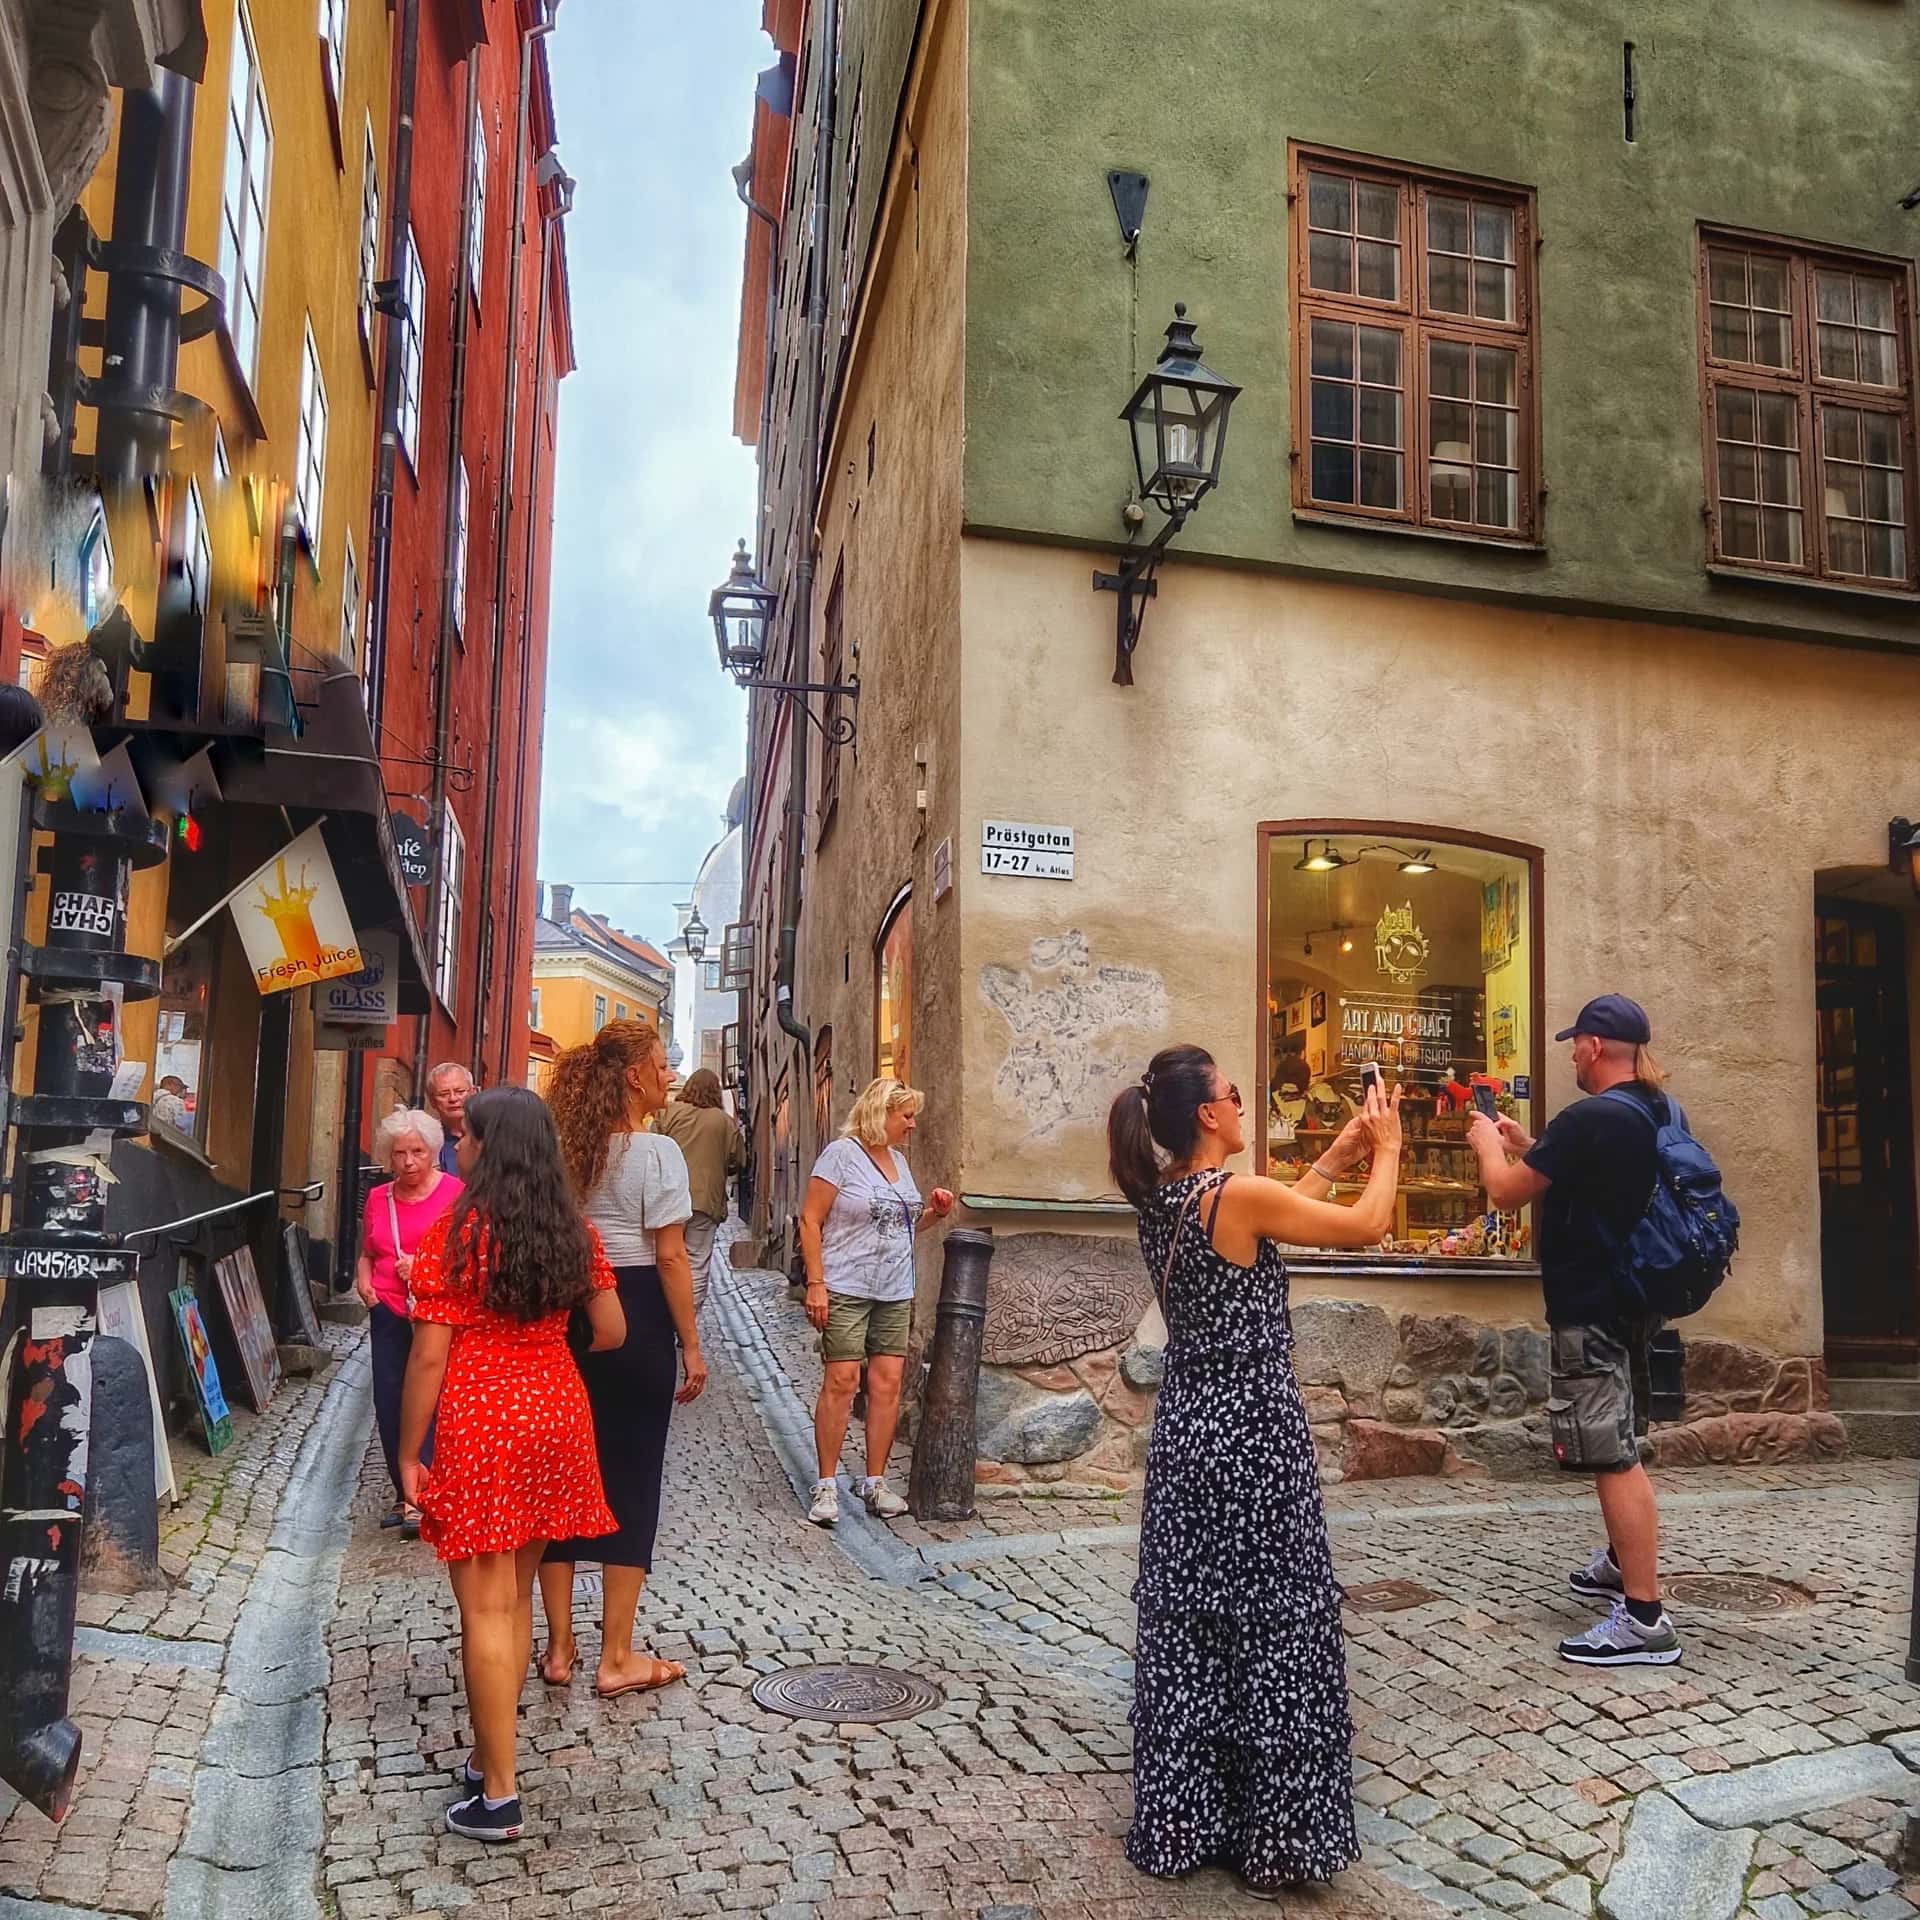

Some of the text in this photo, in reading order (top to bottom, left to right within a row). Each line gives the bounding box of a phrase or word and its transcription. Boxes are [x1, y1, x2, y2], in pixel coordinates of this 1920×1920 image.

[987, 826, 1070, 848] Prästgatan
[986, 852, 1030, 871] 17-27
[55, 893, 114, 915] CHAF
[52, 910, 111, 932] CHAF
[257, 947, 357, 981] Fresh Juice
[329, 989, 385, 1008] GLASS
[1342, 1007, 1453, 1038] ART AND CRAFT
[1404, 1046, 1453, 1066] GIFTSHOP
